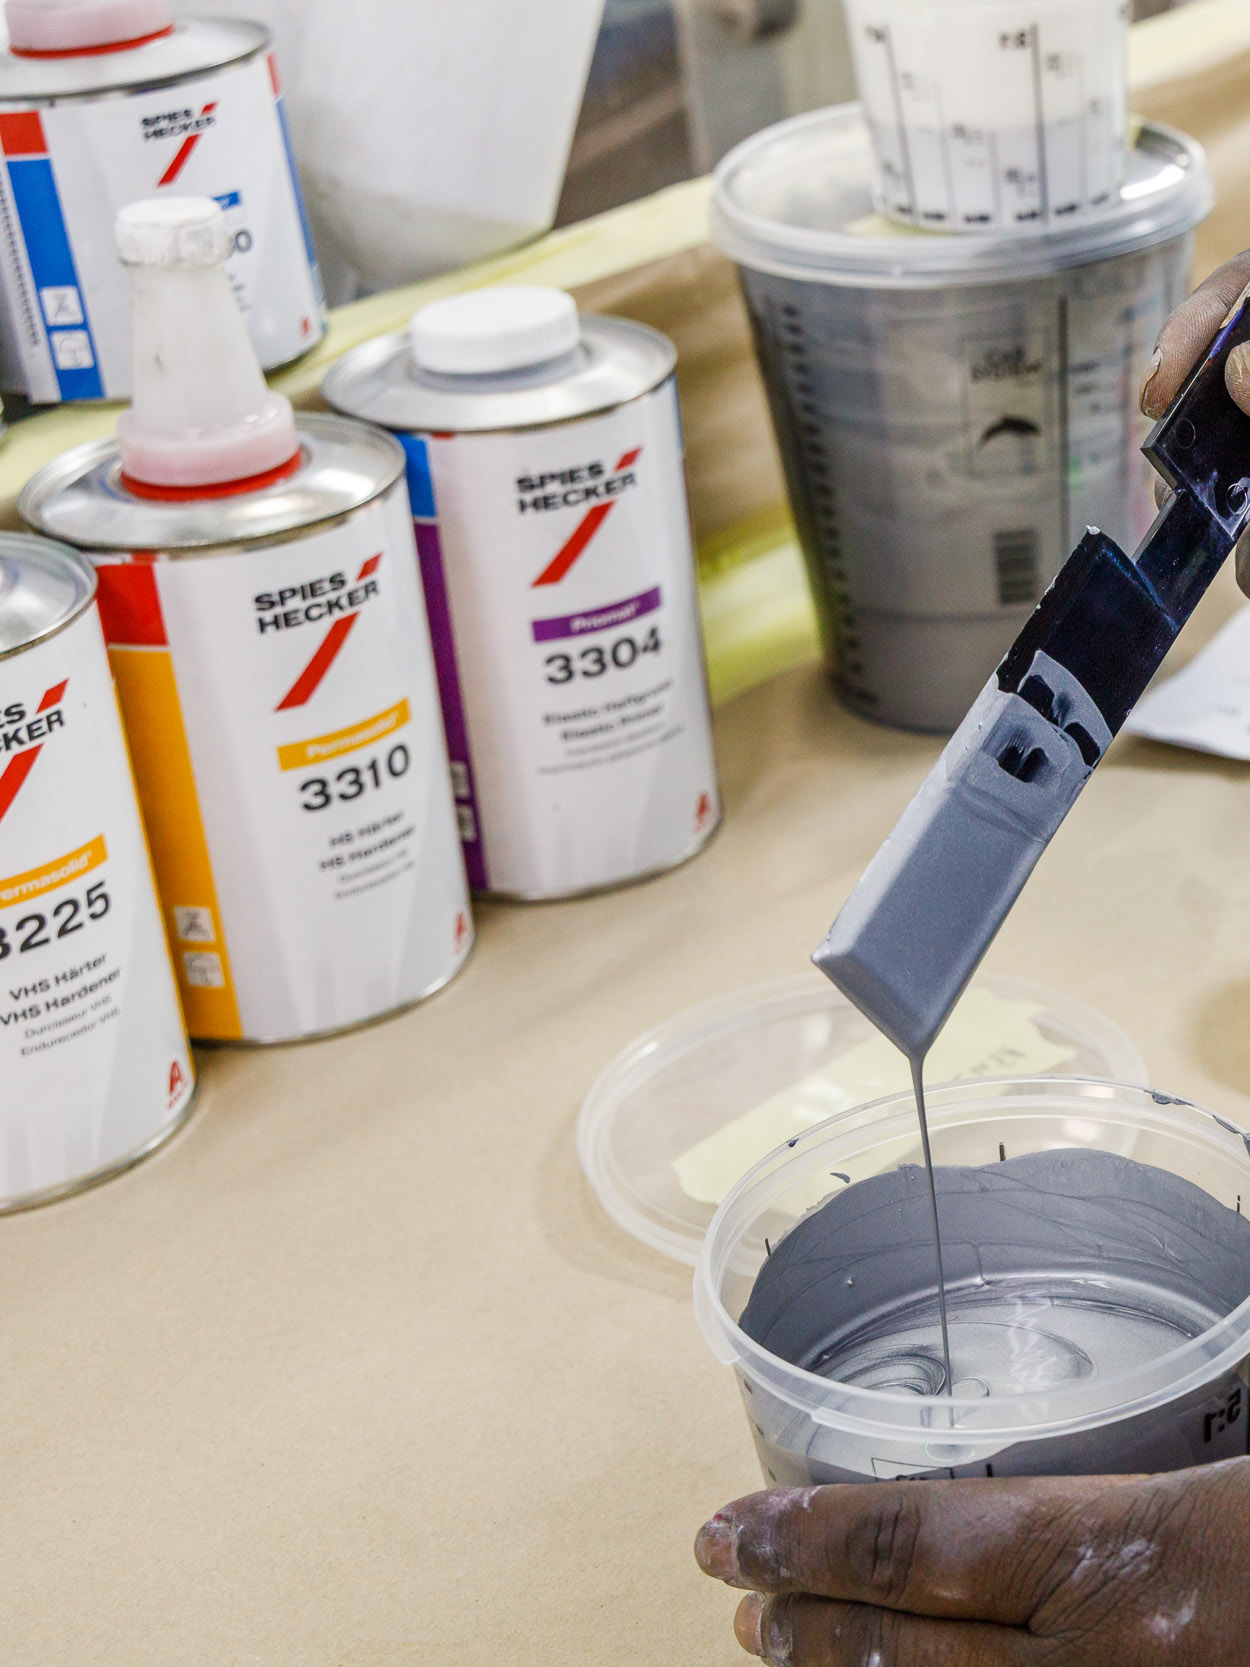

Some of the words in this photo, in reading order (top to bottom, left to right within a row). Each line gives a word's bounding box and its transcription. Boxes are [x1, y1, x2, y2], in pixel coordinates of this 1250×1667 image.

[516, 461, 604, 493] SPIES
[518, 472, 637, 514] HECKER
[254, 572, 347, 612] SPIES
[257, 580, 379, 634] HECKER
[546, 626, 662, 684] 3304
[0, 709, 65, 752] KER
[300, 744, 410, 812] 3310
[0, 852, 89, 900] ermasolid
[0, 1005, 41, 1026] VHS
[45, 967, 121, 1012] Hardener
[9, 979, 51, 1002] VHS
[54, 953, 106, 986] Härter
